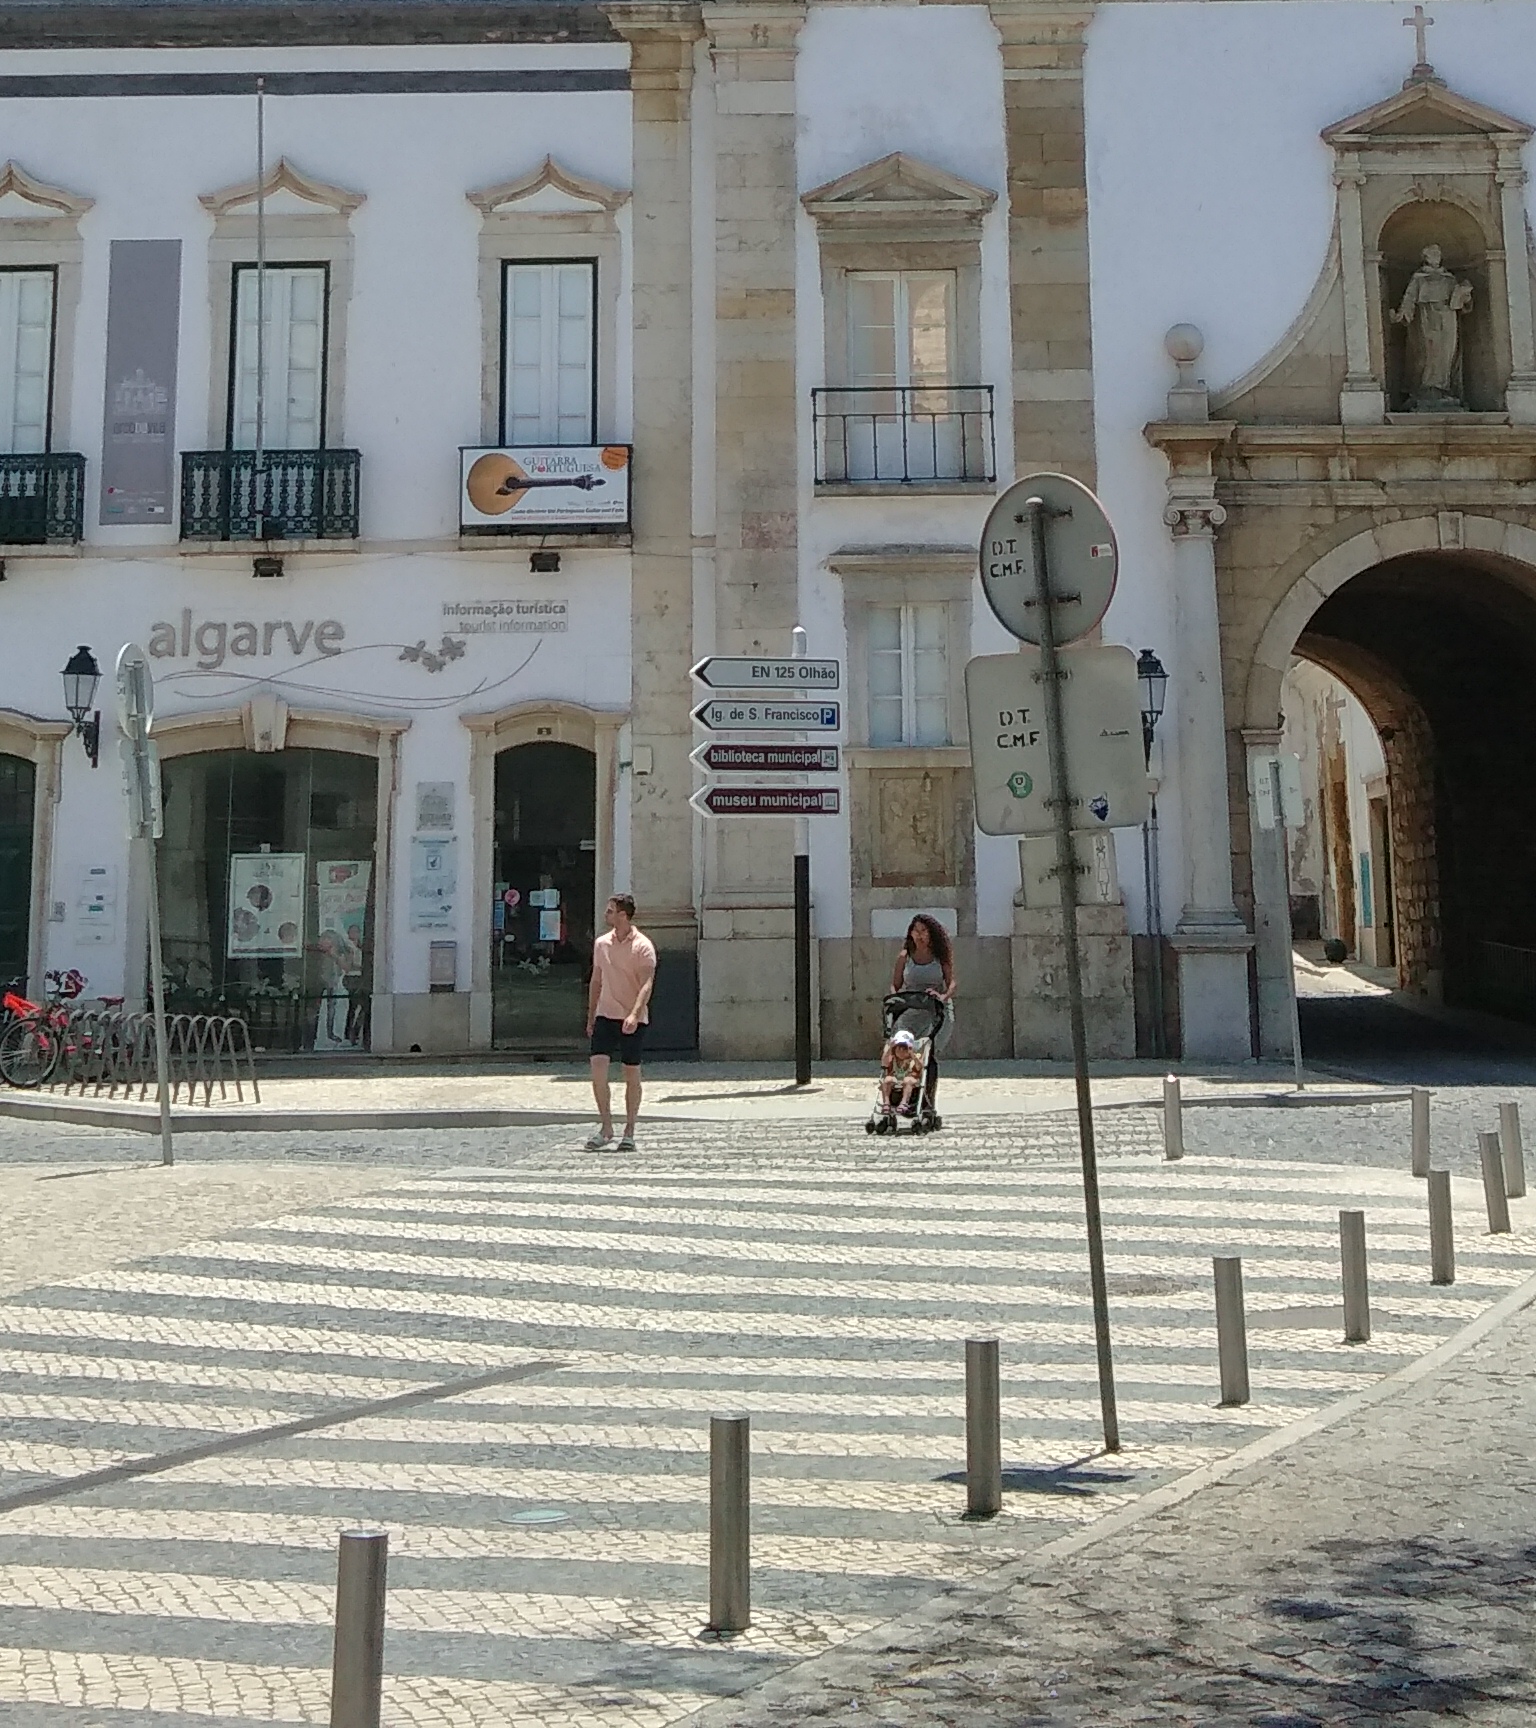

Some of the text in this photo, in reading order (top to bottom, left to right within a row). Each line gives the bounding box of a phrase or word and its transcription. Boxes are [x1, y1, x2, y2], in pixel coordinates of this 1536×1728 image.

[523, 456, 577, 466] GUITARRA
[531, 464, 601, 473] PORTUGUESA
[443, 602, 514, 618] informação
[459, 619, 566, 632] tourist information
[148, 607, 346, 670] algarve
[751, 665, 836, 679] EN 125 Olhão
[729, 707, 745, 720] de
[748, 707, 760, 720] S.
[764, 707, 820, 720] Francisco
[823, 709, 833, 724] P
[710, 749, 821, 766] biblioteca municipal
[712, 793, 822, 810] museu municipal
